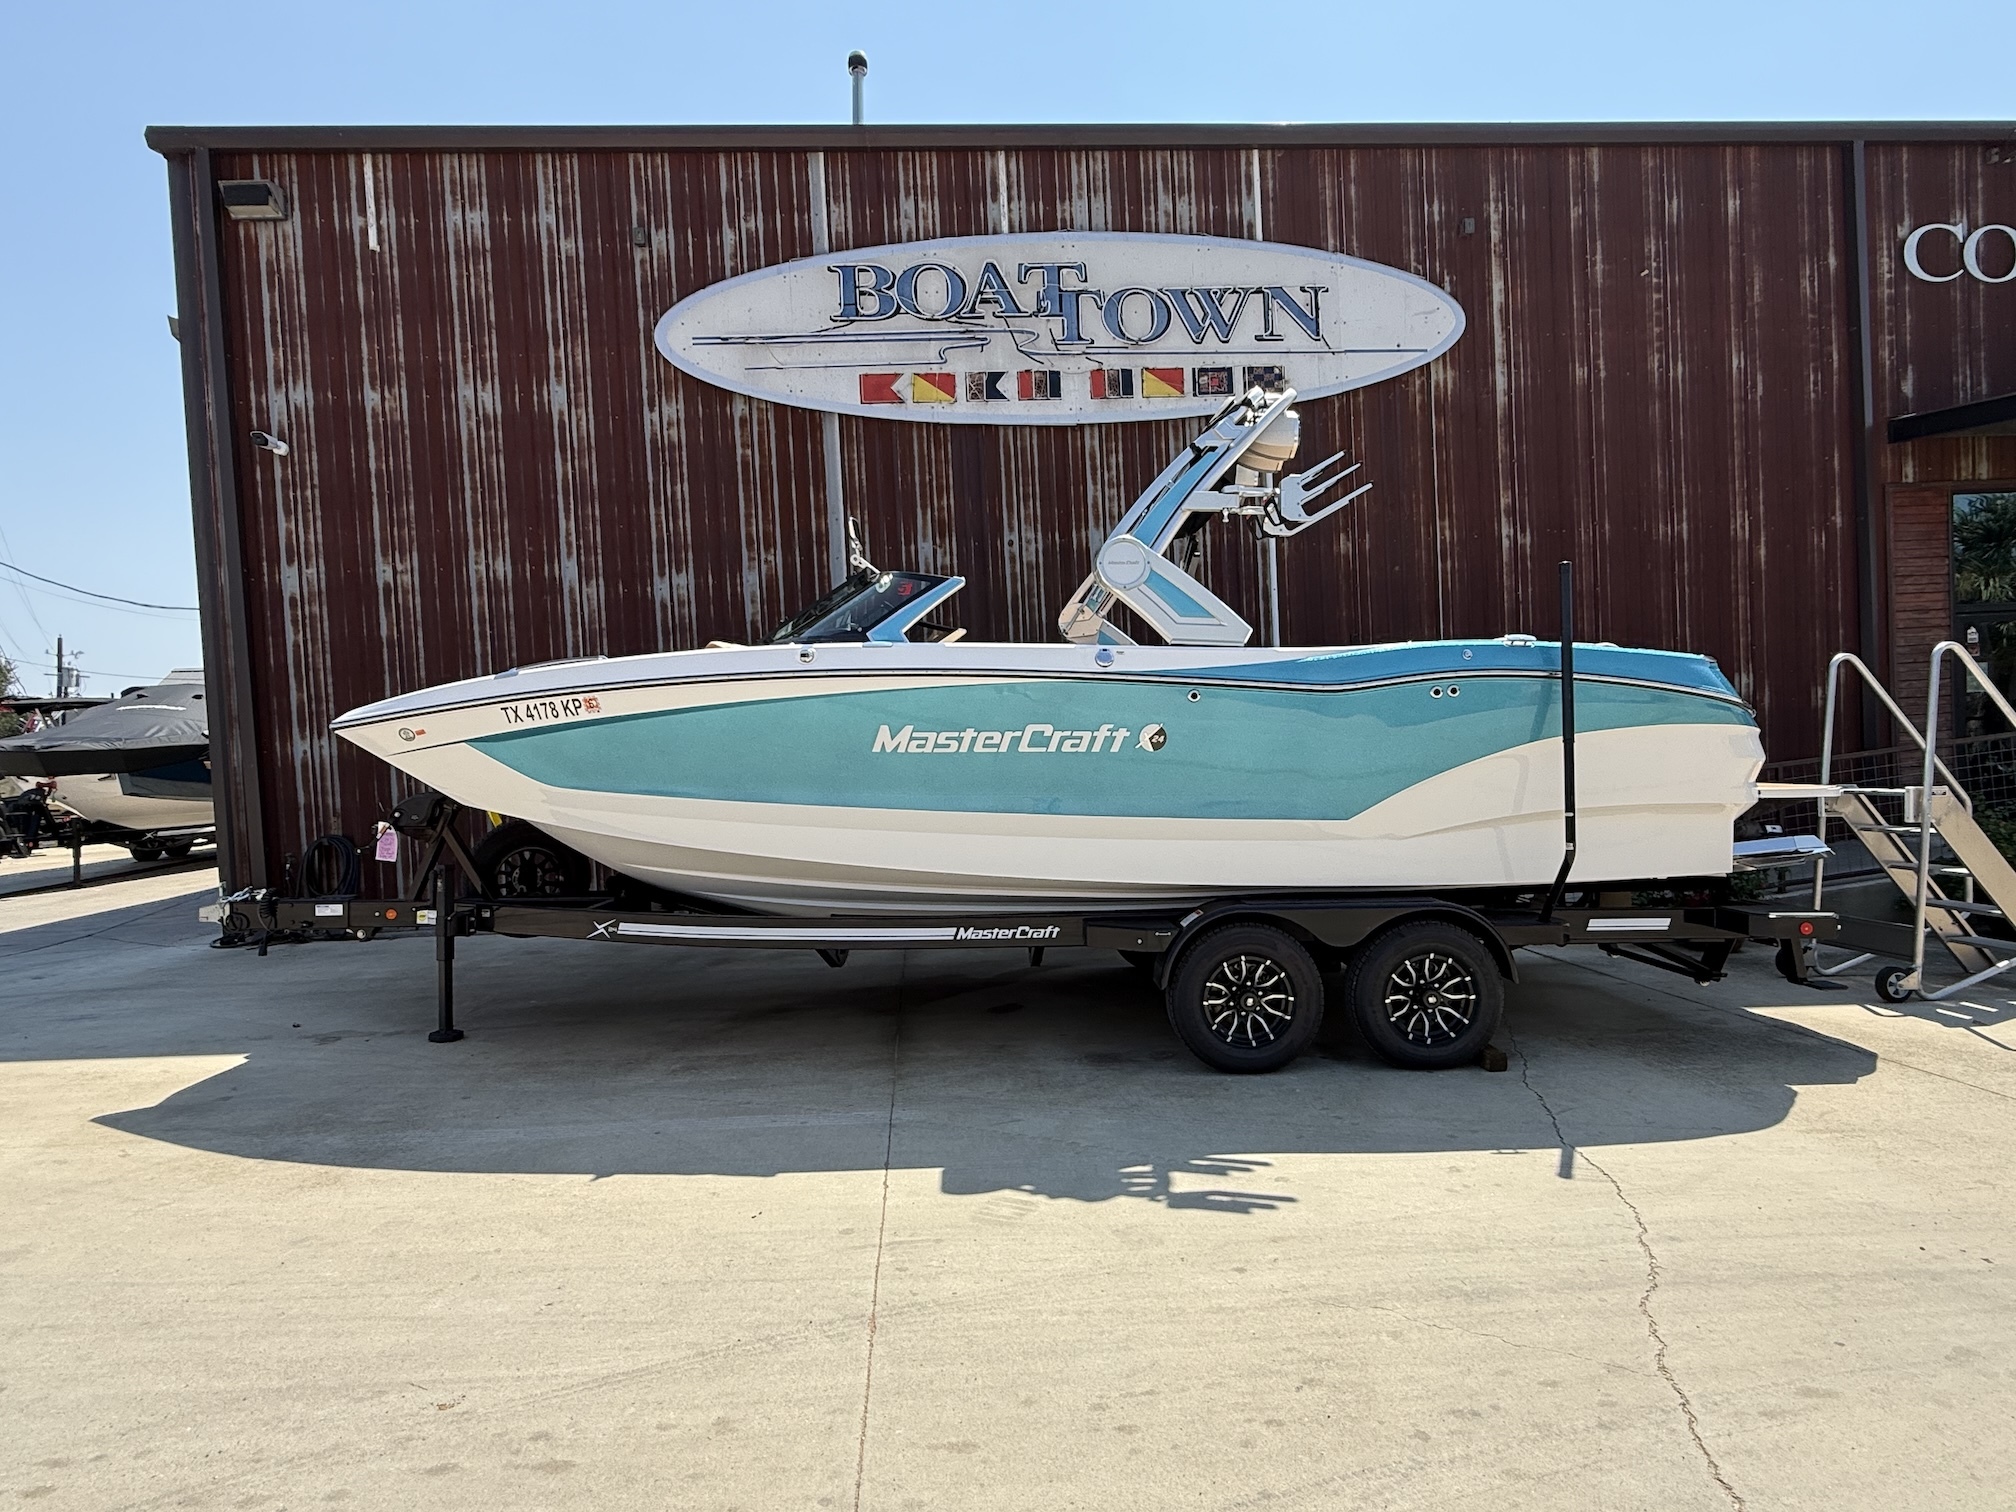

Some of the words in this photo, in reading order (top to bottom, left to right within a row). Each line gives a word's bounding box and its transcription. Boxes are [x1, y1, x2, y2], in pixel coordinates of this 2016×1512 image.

[500, 705, 524, 724] TX
[526, 701, 559, 721] 4178
[560, 698, 582, 716] KP
[871, 723, 1131, 753] MasterCraft
[956, 925, 1061, 940] MasterCraft
